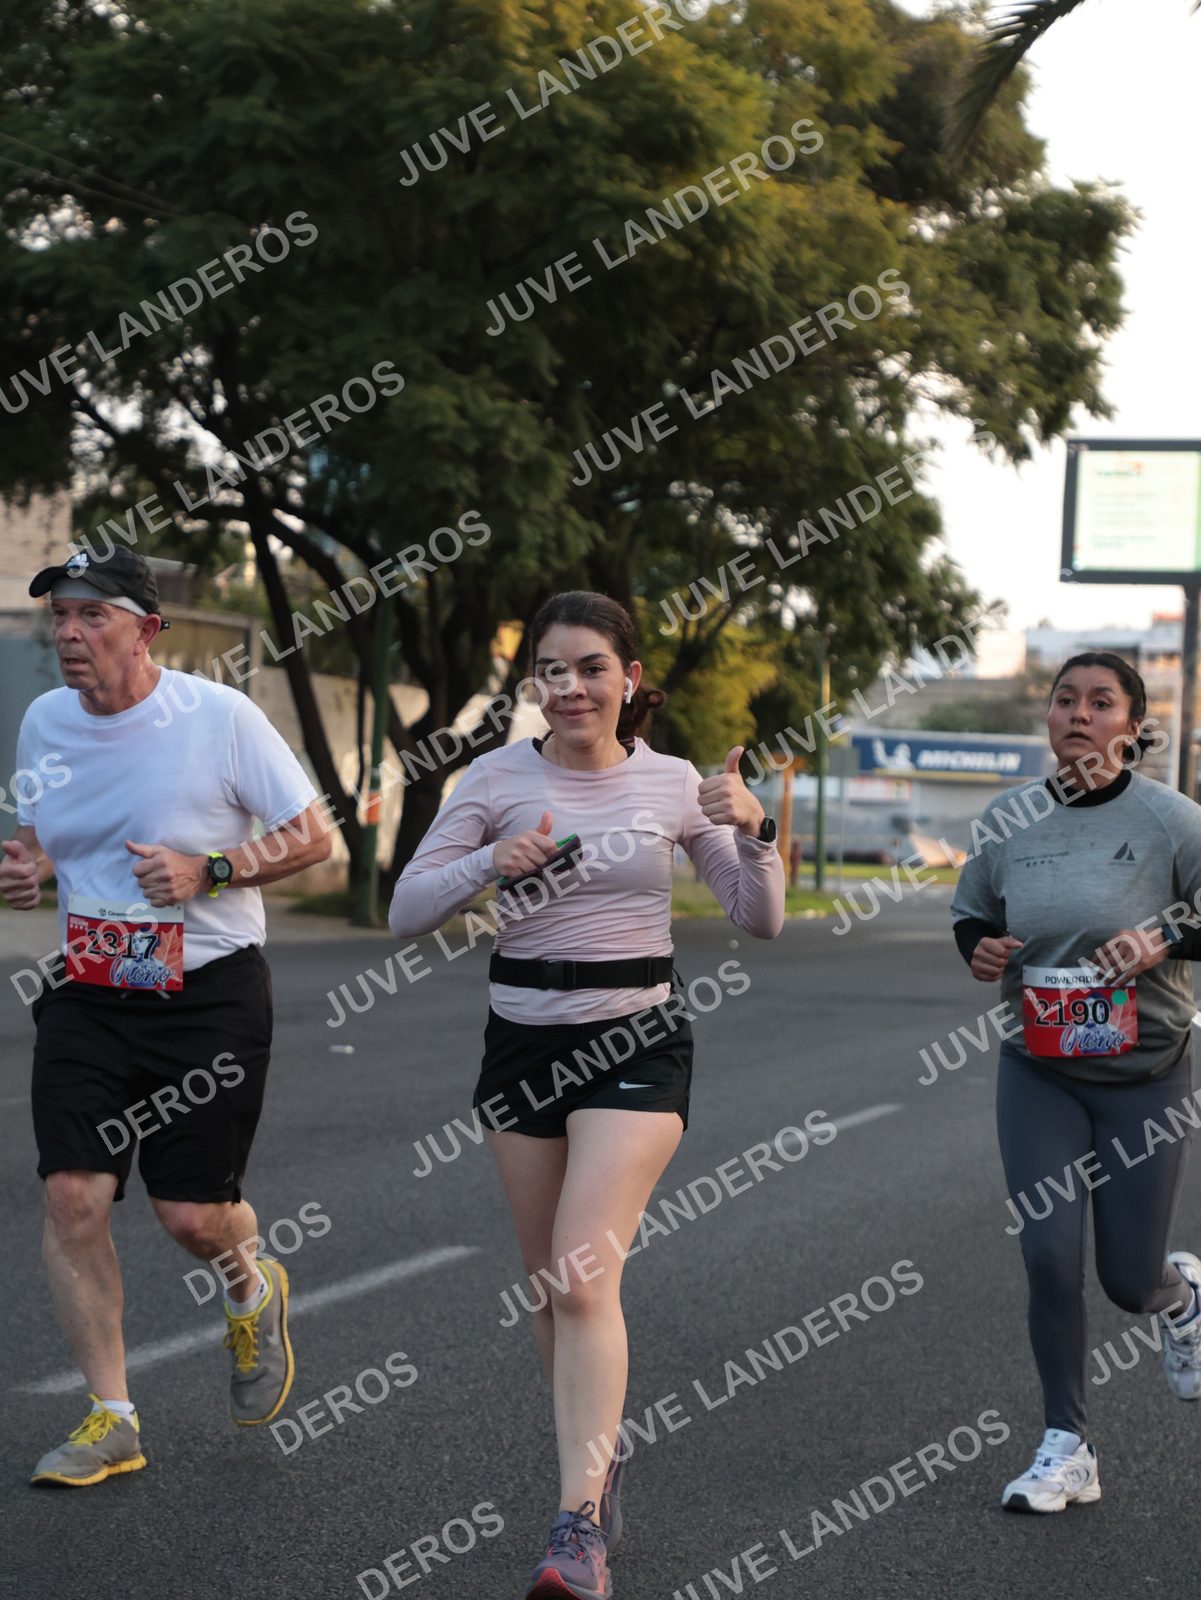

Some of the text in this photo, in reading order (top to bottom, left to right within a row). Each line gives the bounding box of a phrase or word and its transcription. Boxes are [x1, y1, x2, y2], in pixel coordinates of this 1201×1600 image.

[917, 749, 1021, 772] MICHELIN
[87, 928, 158, 960] 2317
[1035, 998, 1111, 1027] 2190
